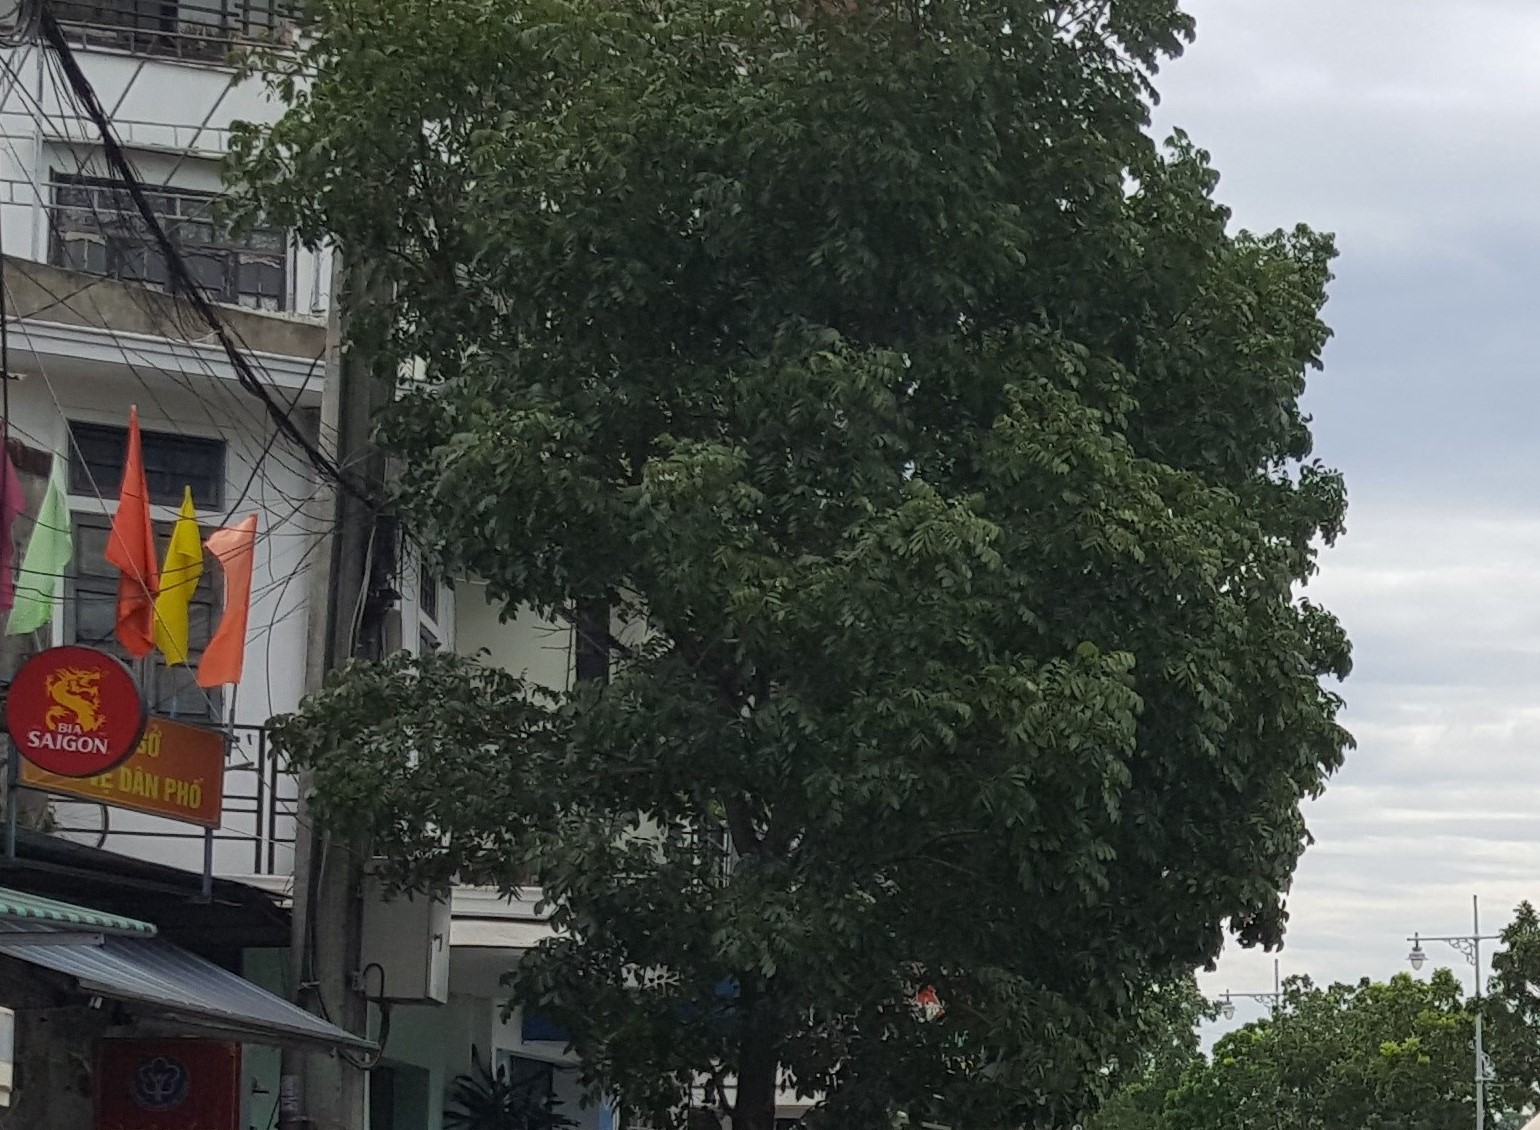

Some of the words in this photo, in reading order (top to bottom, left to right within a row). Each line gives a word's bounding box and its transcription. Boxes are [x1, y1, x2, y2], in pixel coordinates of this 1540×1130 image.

[58, 722, 82, 734] BIA
[27, 730, 109, 755] SAIGON
[119, 766, 159, 799] DÂN
[164, 777, 204, 808] PHỐ
